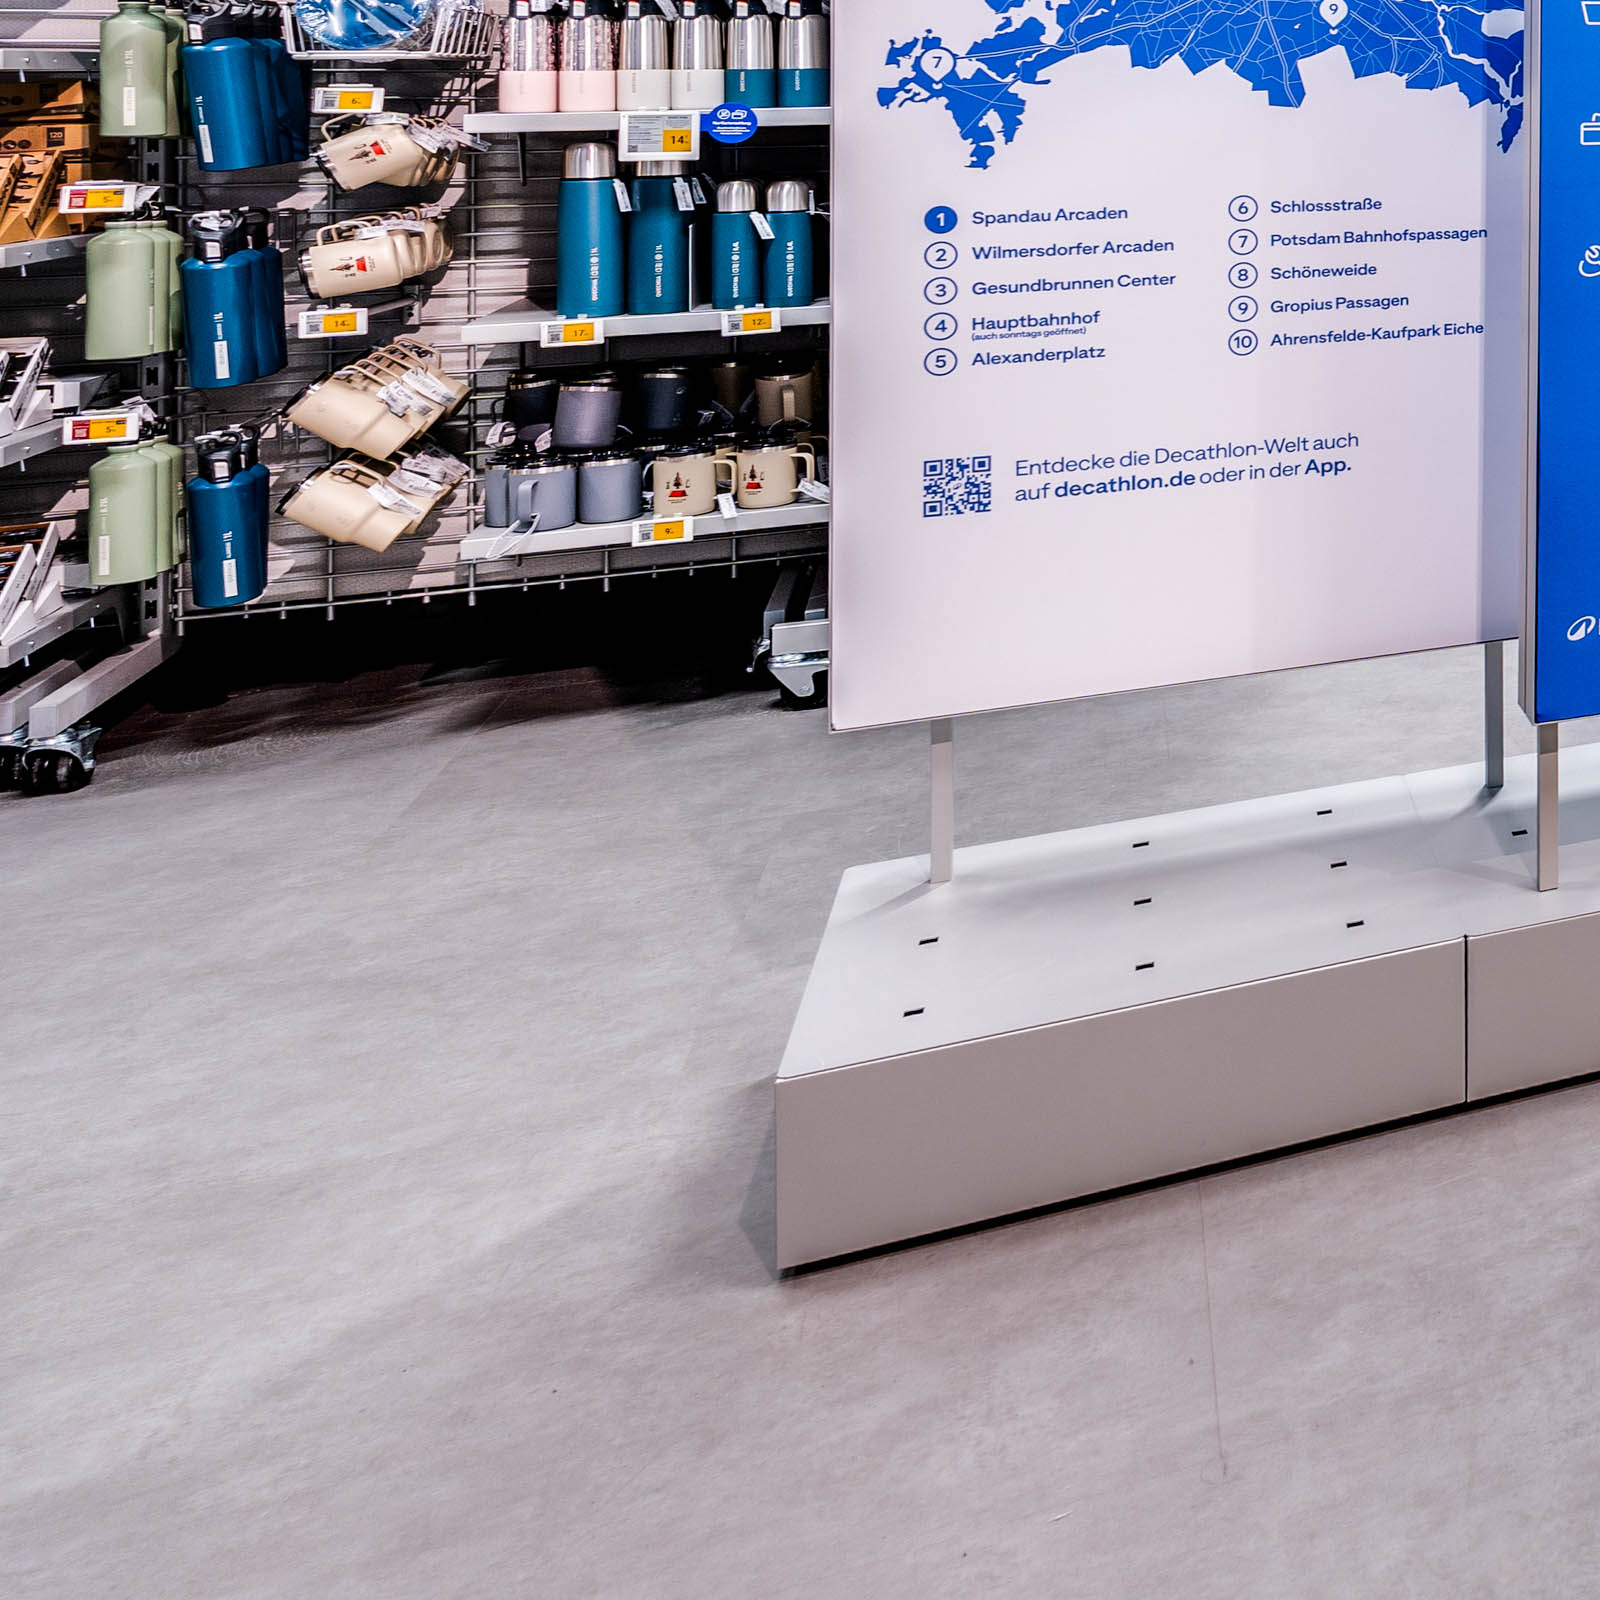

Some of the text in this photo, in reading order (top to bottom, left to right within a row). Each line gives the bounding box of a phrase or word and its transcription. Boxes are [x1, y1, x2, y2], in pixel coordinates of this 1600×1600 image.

[1328, 3, 1339, 15] 9
[931, 55, 943, 69] 7
[936, 206, 1129, 228] 1 Spandau Arcaden
[1236, 197, 1383, 216] 6 Schlossstraße
[1238, 227, 1490, 248] 7 Potsdam Bahnhofspassagen
[935, 239, 1175, 262] 2 Wilmersdorfer Arcaden
[1237, 263, 1377, 282] 8 Schöneweide
[935, 272, 1177, 298] 3 Gesundbrunnen Center
[1237, 294, 1410, 318] 9 Gropius Passagen
[934, 310, 1101, 333] 4 Hauptbahnhof
[971, 332, 998, 342] (auch
[998, 331, 1043, 339] sonntags
[1232, 320, 1487, 351] 10 Ahrensfelde-Kaufpark Eiche
[935, 346, 1106, 369] 5 Alexanderplatz
[1015, 432, 1359, 477] Entdecke die Decathlon-Welt auch
[1015, 458, 1352, 502] auf decathlon.de oder in der App.
